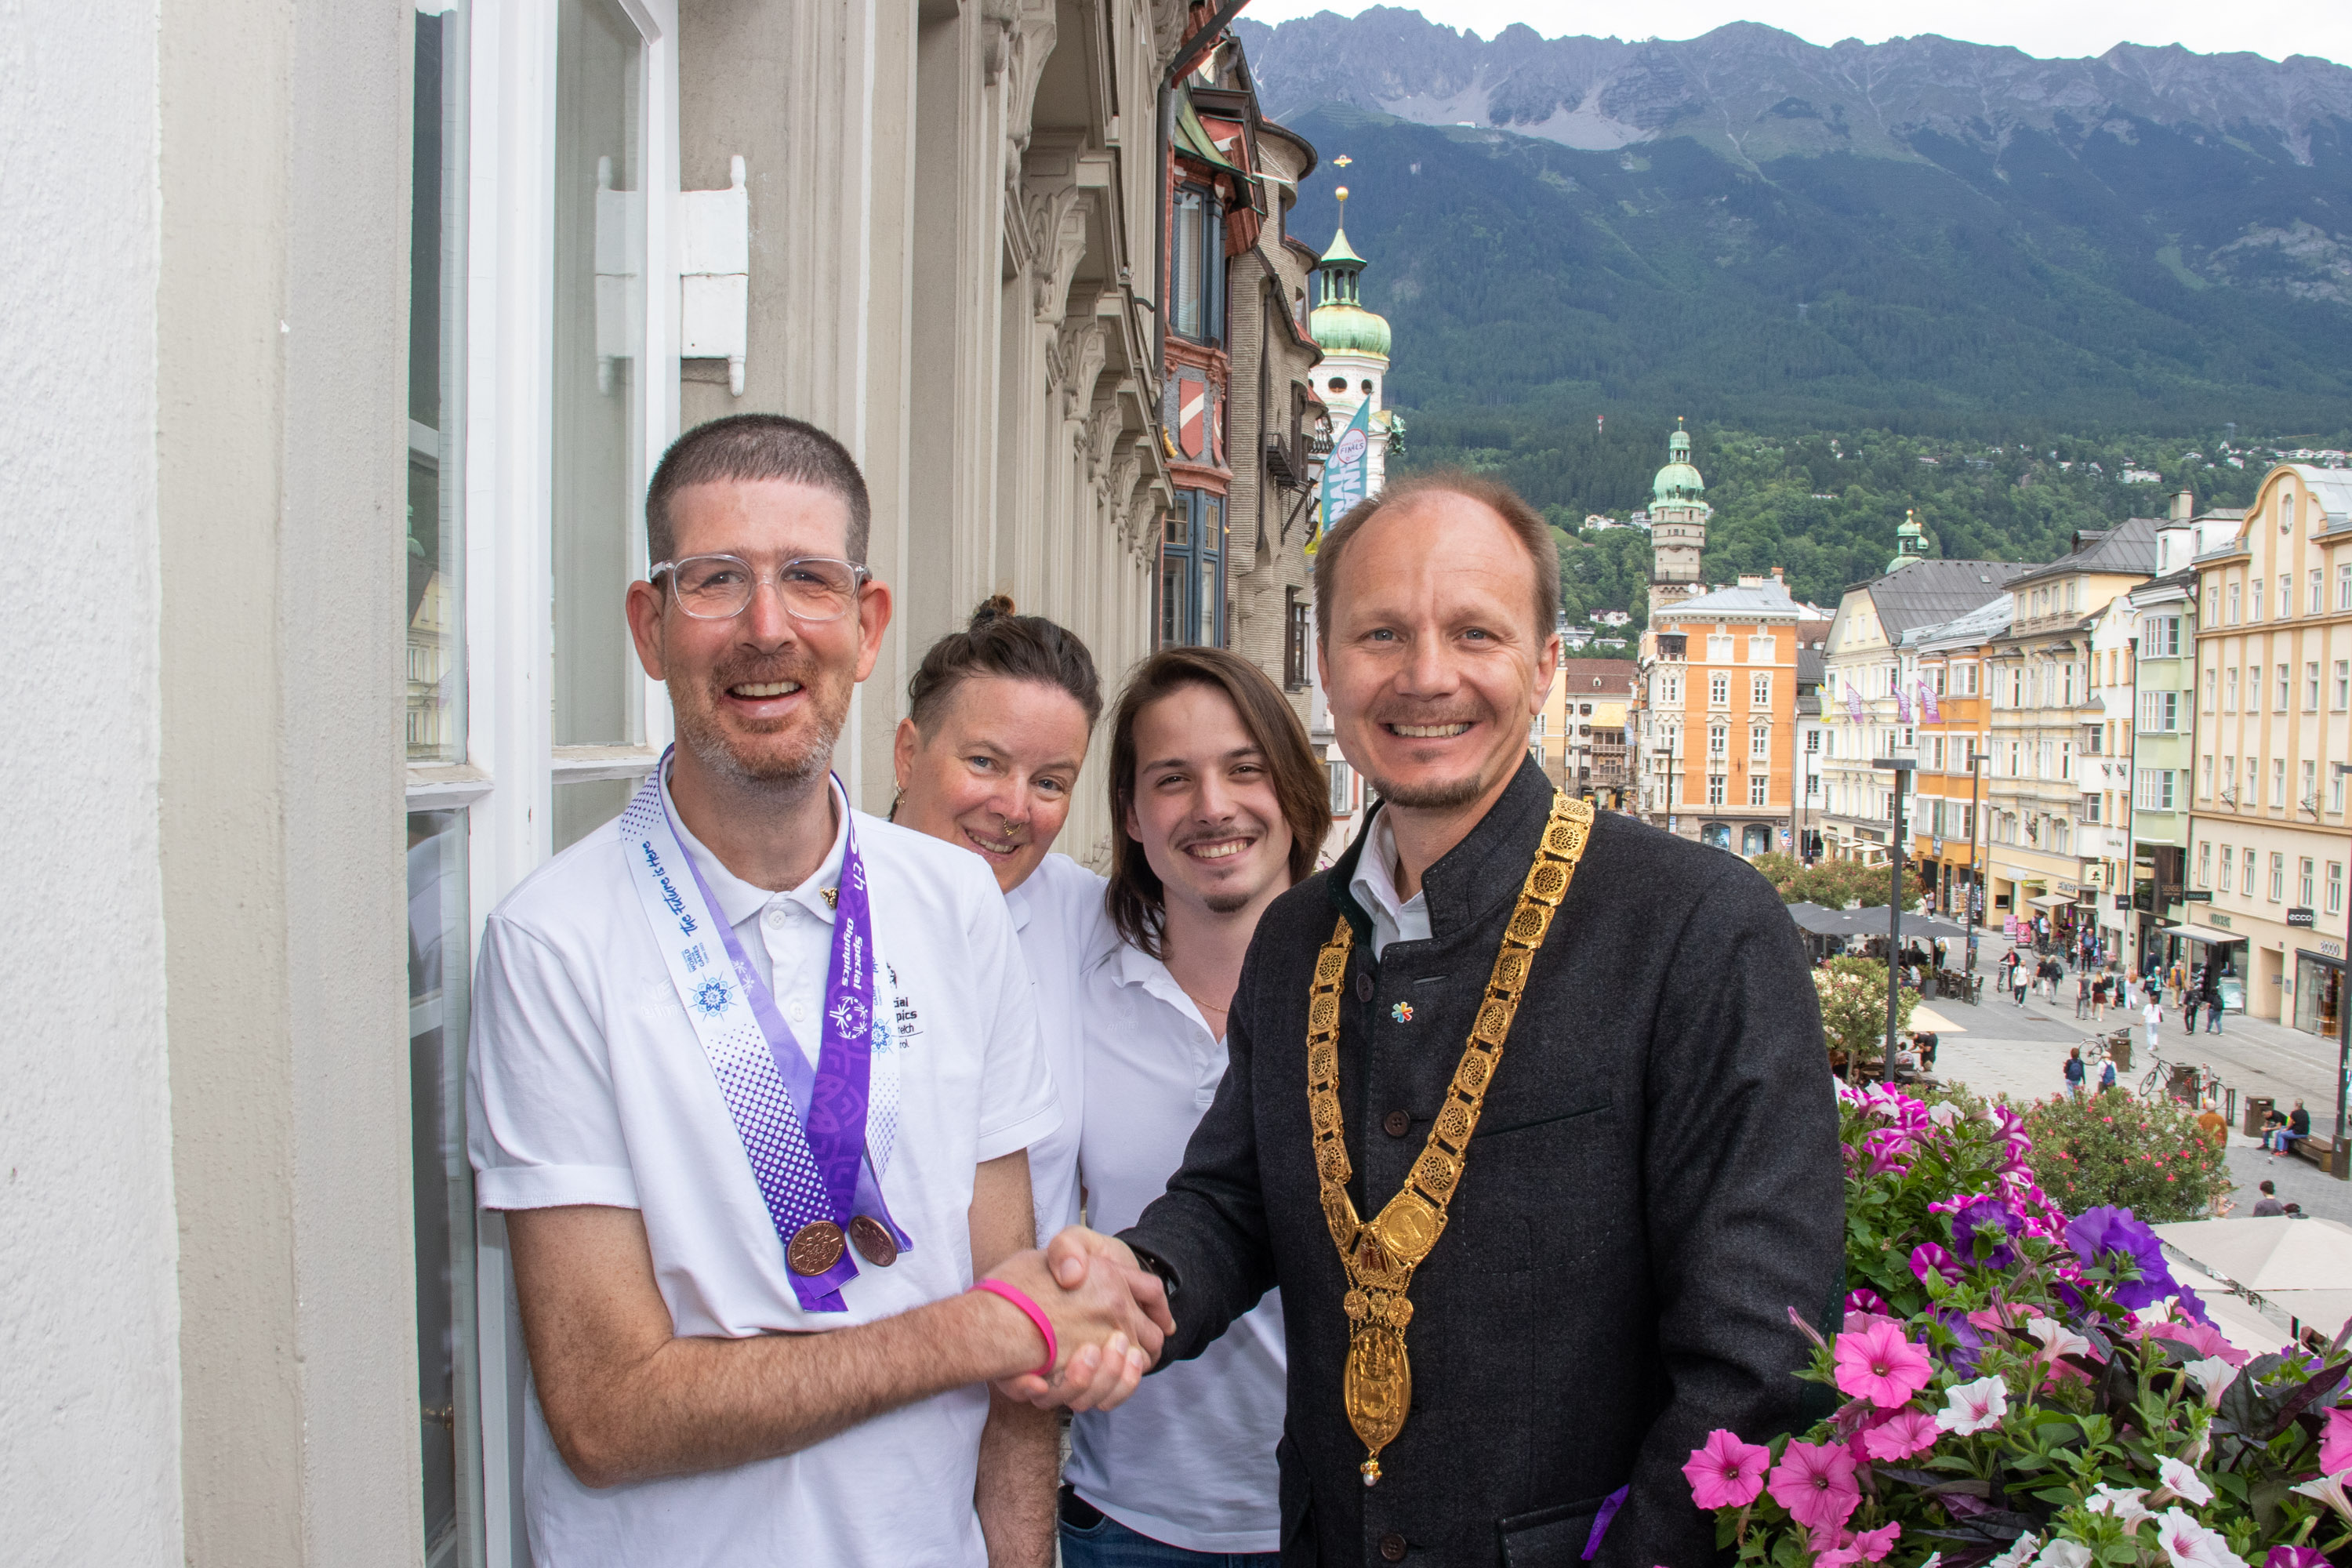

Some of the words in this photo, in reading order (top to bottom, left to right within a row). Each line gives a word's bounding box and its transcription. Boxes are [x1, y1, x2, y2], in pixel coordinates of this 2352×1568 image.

[642, 840, 660, 867] Here
[652, 866, 666, 877] is
[660, 877, 686, 916] Future
[679, 914, 698, 937] The
[692, 945, 705, 967] GAMES
[841, 918, 855, 987] Olympics
[2321, 940, 2340, 956] ecco
[684, 949, 697, 972] WORLD
[853, 935, 864, 990] Special
